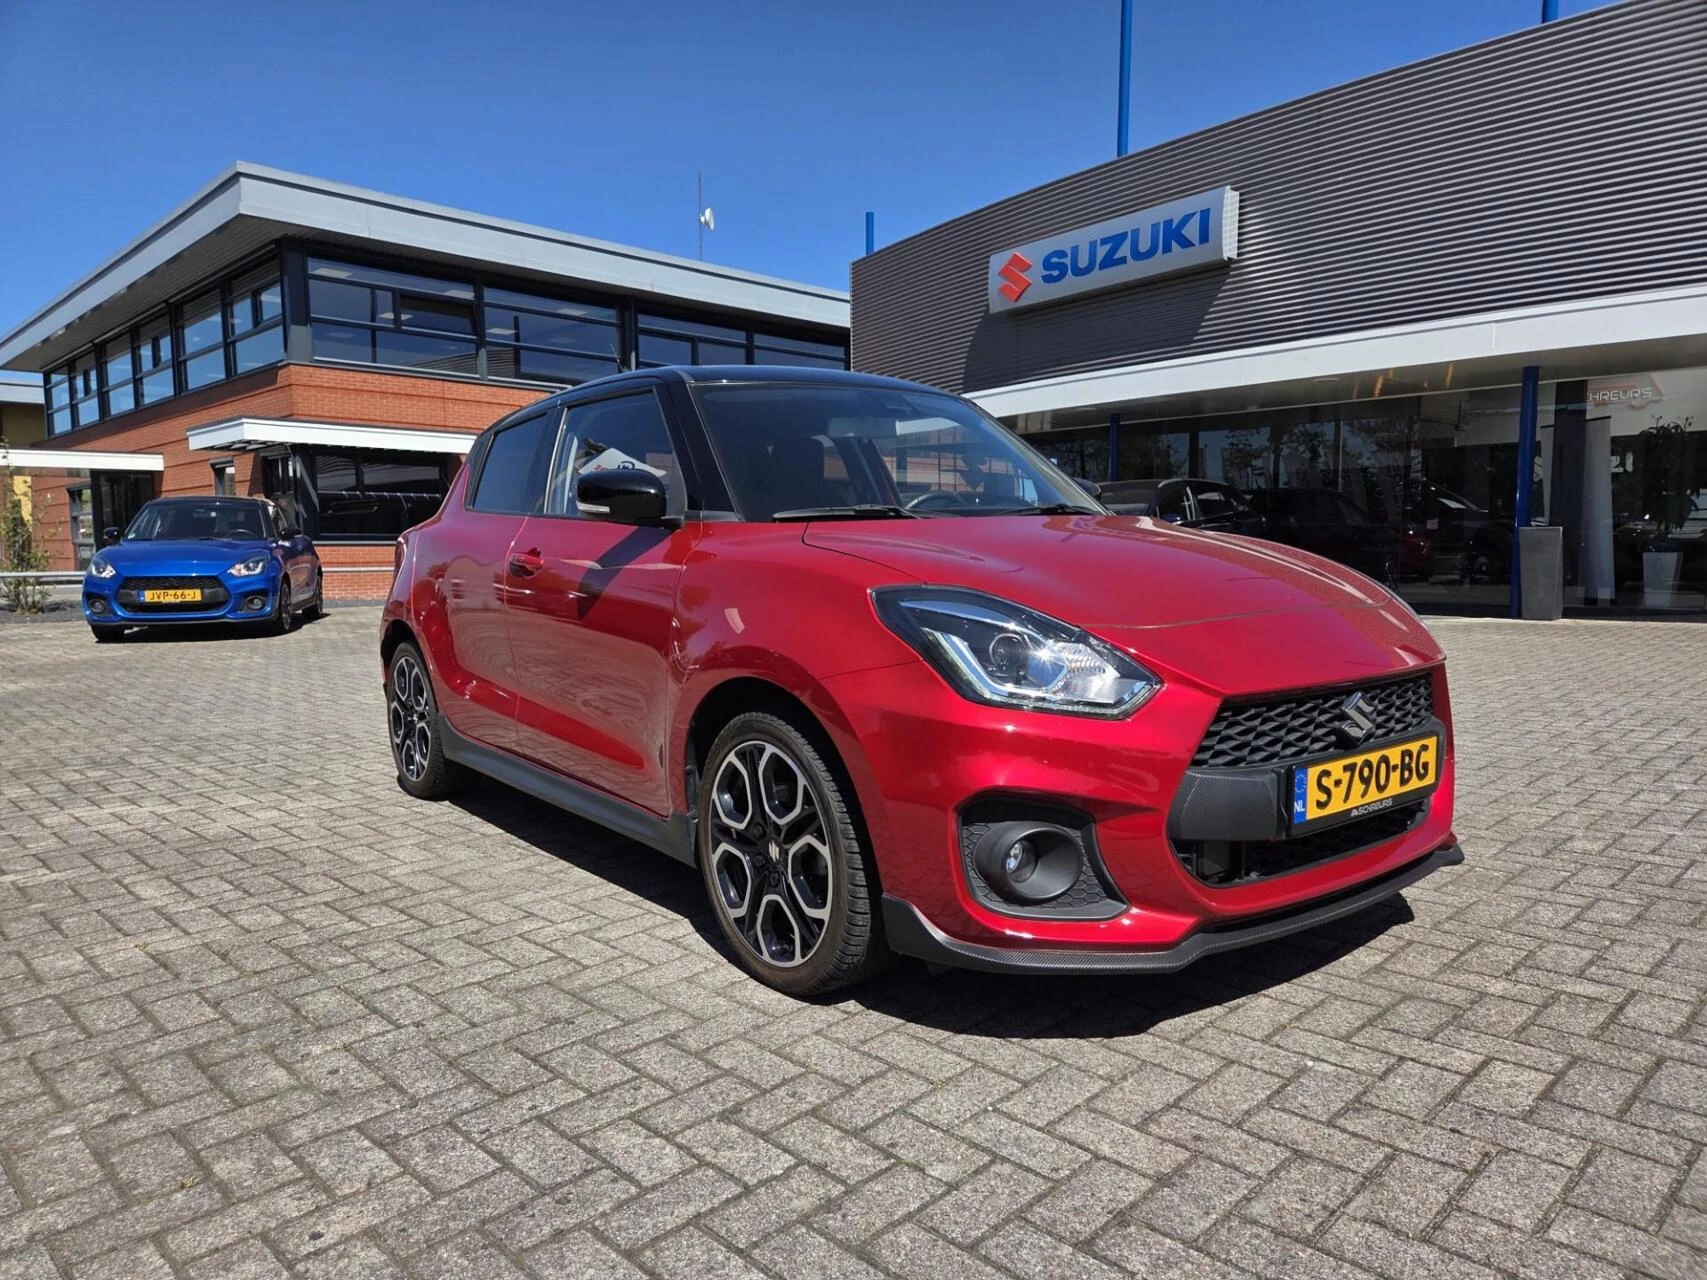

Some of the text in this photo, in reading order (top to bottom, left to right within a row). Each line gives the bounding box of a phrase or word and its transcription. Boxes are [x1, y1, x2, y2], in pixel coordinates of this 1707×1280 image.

[1040, 207, 1211, 284] SUZUKI
[149, 591, 196, 600] JVP-66-J
[1315, 743, 1430, 811] S-790-BG
[1293, 799, 1306, 813] NL
[1358, 797, 1393, 815] SCHREURS
